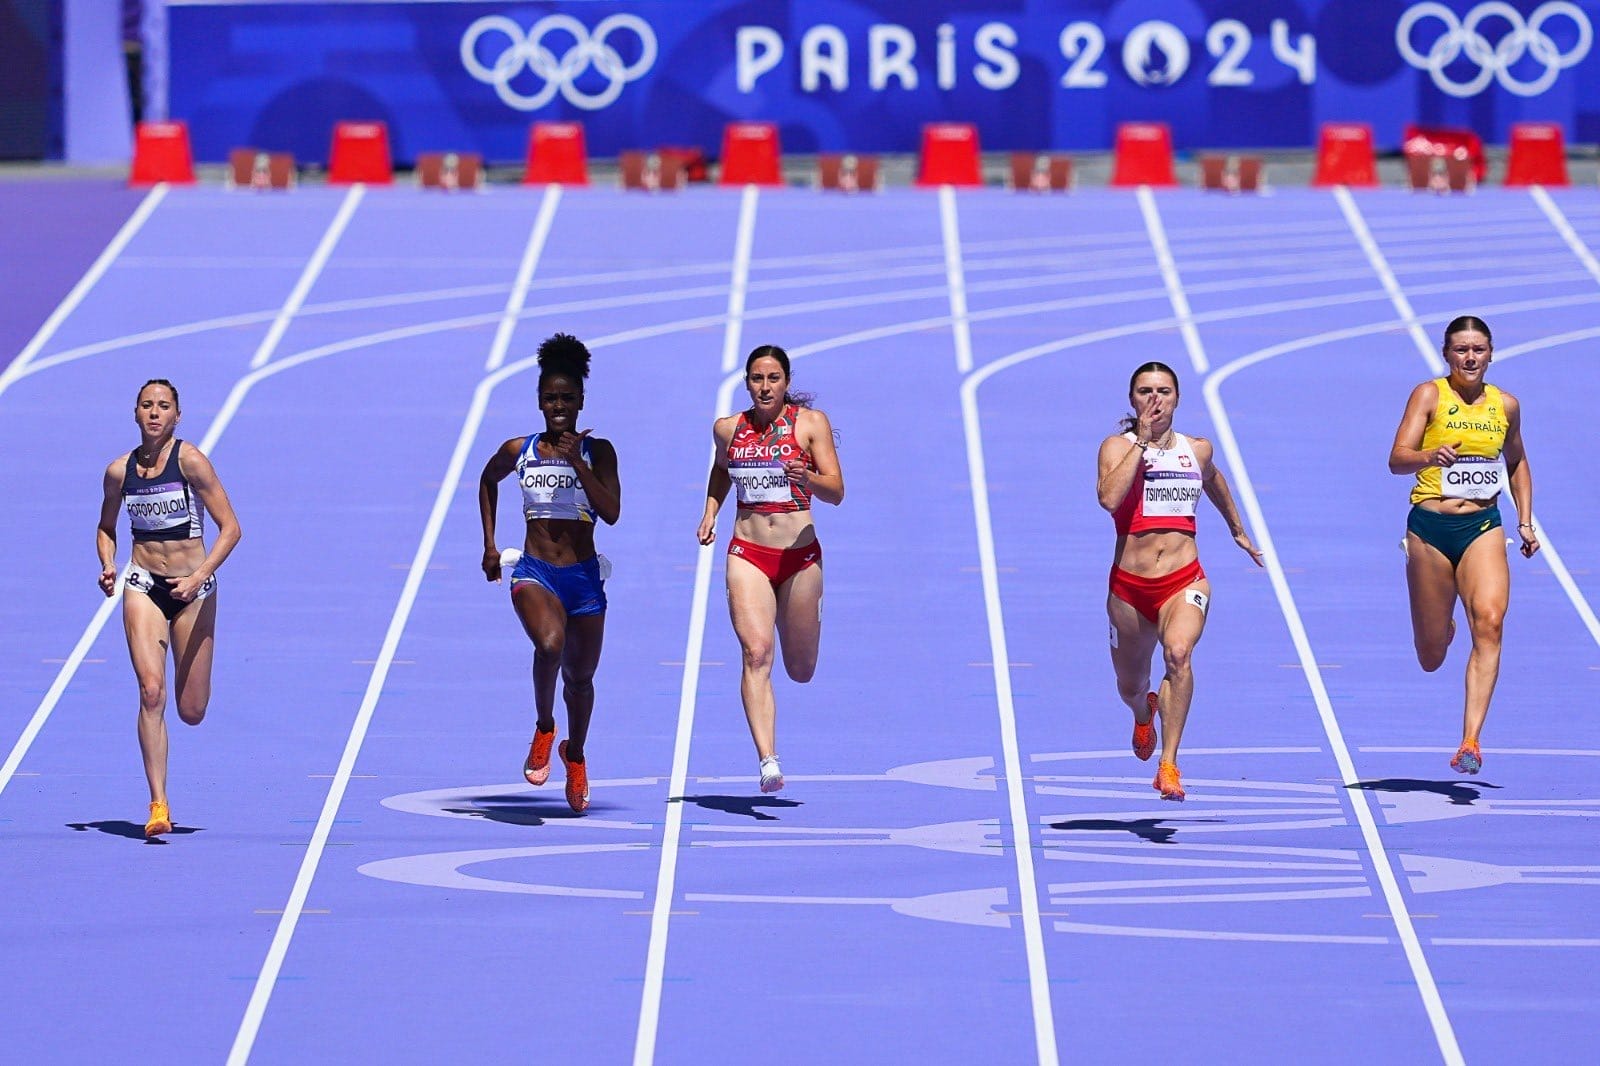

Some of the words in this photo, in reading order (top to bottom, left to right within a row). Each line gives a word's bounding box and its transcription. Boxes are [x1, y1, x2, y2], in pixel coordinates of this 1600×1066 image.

[1446, 421, 1502, 432] AUSTRALIA
[733, 443, 792, 459] MÉXICO
[525, 475, 583, 489] CAICEDO
[1447, 471, 1498, 484] GROSS
